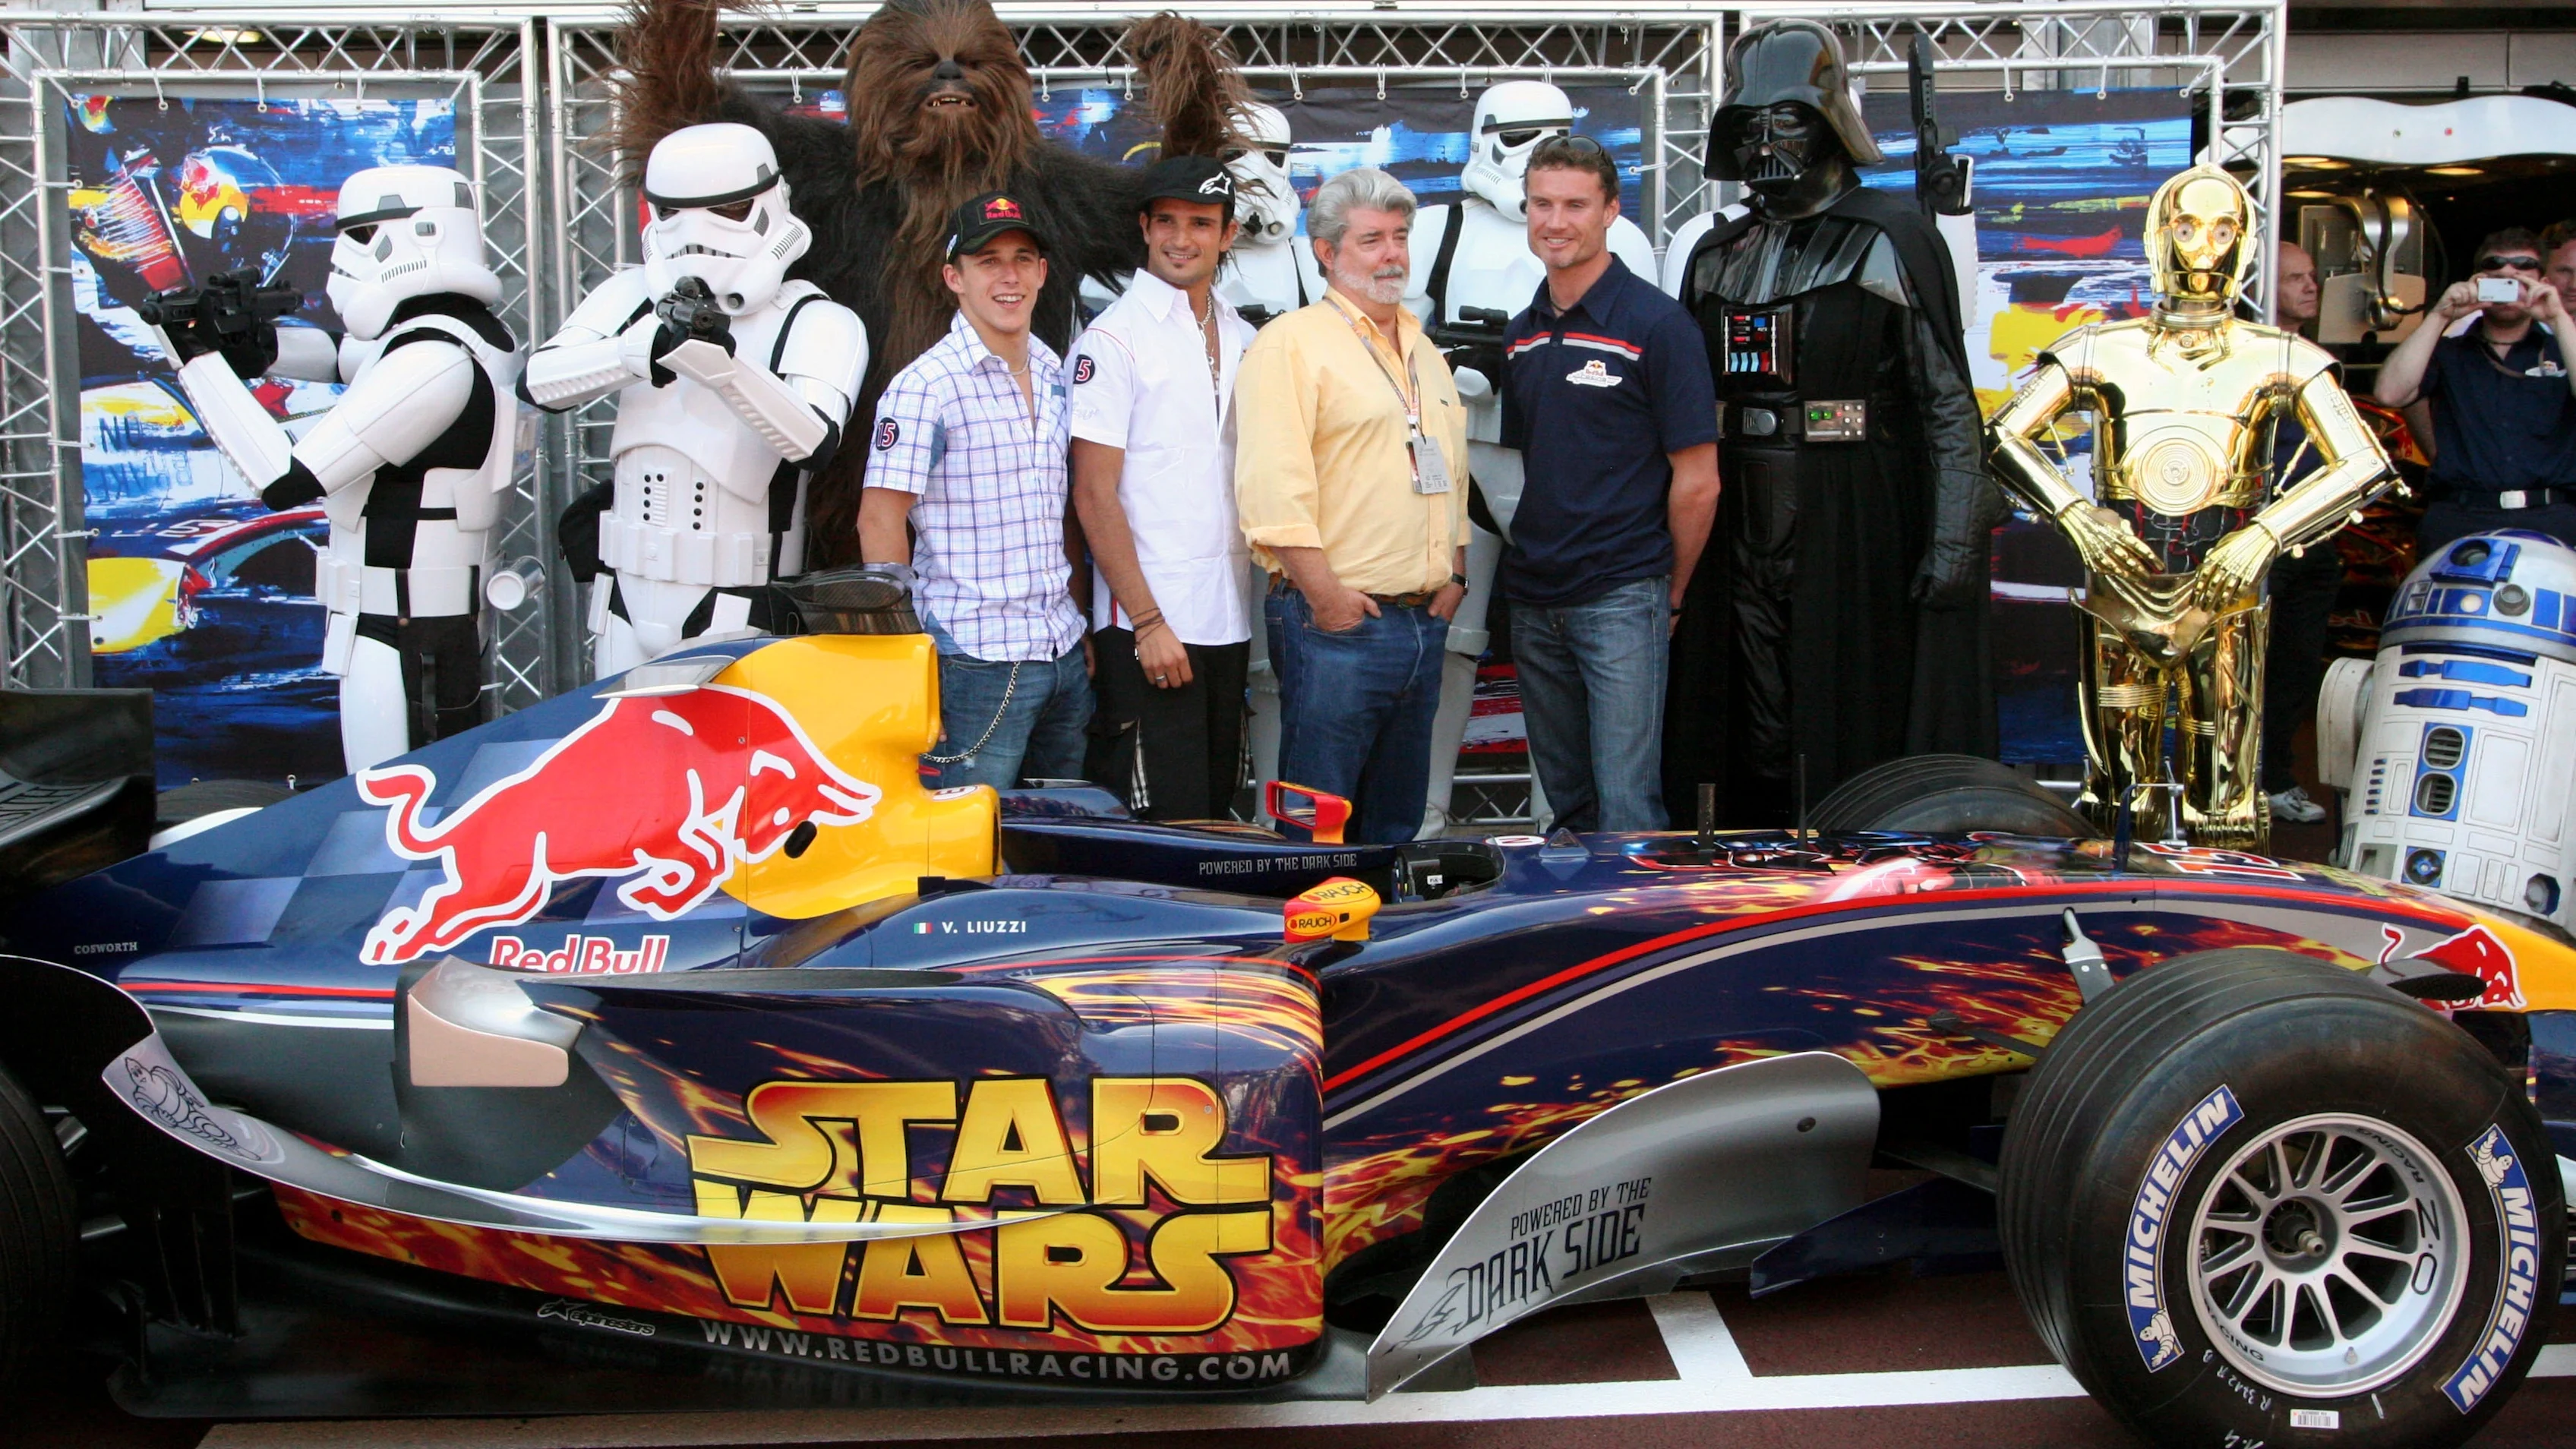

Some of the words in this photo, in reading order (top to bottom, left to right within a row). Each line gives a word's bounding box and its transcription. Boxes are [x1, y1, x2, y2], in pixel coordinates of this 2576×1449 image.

[877, 422, 896, 447] 15
[1199, 860, 1252, 875] POWERED
[1257, 858, 1271, 872] BY
[1275, 856, 1299, 872] THE
[1302, 854, 1330, 870] DARK
[1333, 853, 1357, 867] SIDE
[1314, 882, 1372, 899] RAUCH
[74, 942, 137, 954] COSWORTH
[942, 921, 958, 933] V.
[967, 920, 1026, 933] LIUZZI
[1299, 916, 1332, 928] RAUCH
[489, 934, 581, 973] Red
[579, 935, 670, 974] Bull
[685, 1075, 1274, 1209] STAR
[2356, 1127, 2426, 1184] RACING
[1511, 1194, 1583, 1240] POWERED
[1588, 1186, 1610, 1213] BY
[1617, 1177, 1652, 1204] THE
[2129, 1091, 2230, 1309] MICHELIN
[691, 1177, 1274, 1337] WARS
[1446, 1230, 1555, 1337] DARK
[1561, 1203, 1645, 1280] SIDE
[2458, 1186, 2536, 1407] MICHELIN
[699, 1319, 1292, 1381] WWW.REDBULLRACING.COM
